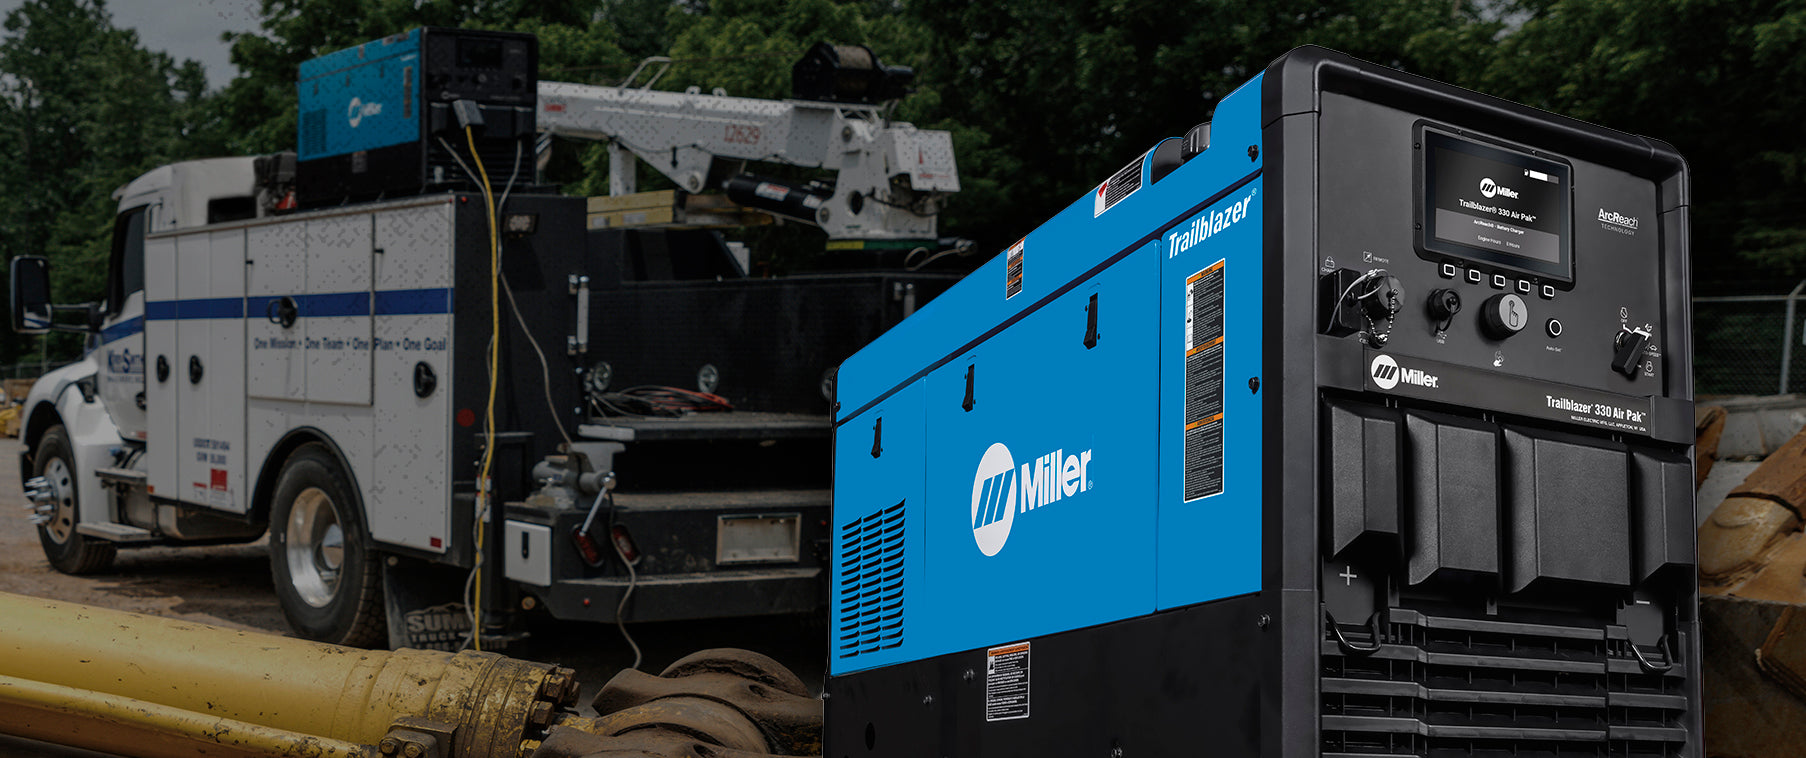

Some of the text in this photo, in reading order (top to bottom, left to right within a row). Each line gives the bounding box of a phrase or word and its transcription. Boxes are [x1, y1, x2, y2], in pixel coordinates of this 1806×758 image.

[1498, 208, 1510, 217] 330
[1511, 211, 1520, 219] Air
[1599, 208, 1639, 227] ArcReach
[254, 336, 447, 351] One Mission One Team One Plan One Goal
[1594, 404, 1612, 418] 330
[1613, 407, 1625, 420] Air
[407, 613, 474, 633] SUM
